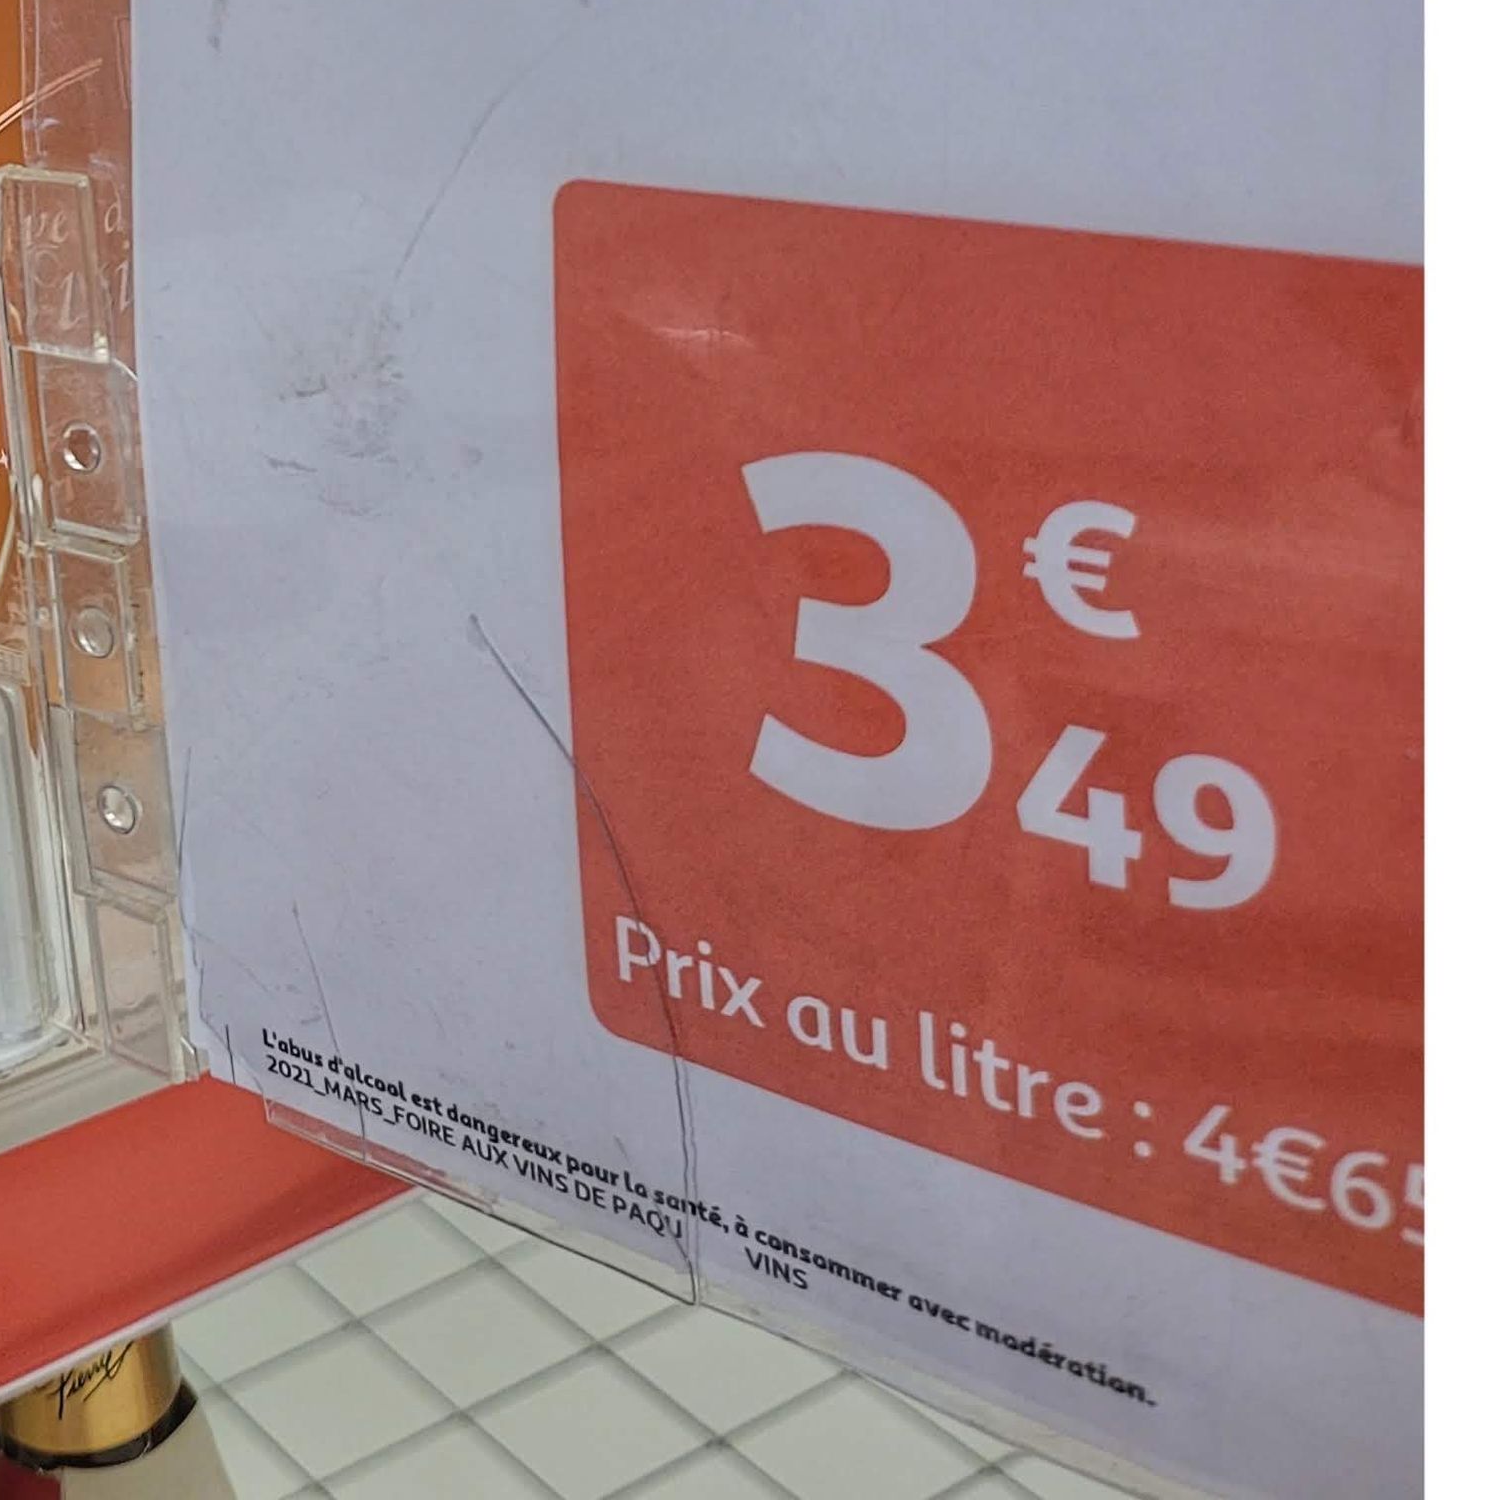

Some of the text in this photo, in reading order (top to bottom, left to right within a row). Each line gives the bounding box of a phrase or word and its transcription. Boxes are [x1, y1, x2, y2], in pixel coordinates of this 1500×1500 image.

[740, 450, 993, 832] 3
[1023, 500, 1141, 640] €
[1016, 724, 1278, 911] 49
[615, 915, 765, 1028] Prix
[787, 994, 888, 1070] au
[918, 1011, 1105, 1139] litre
[262, 1028, 1158, 1407] L'abus d'alcool est dangereux pour la santé, à consommer avec modération.
[461, 1132, 511, 1169] AUX
[513, 1155, 568, 1195] VINS
[575, 1179, 607, 1209] DE
[612, 1194, 683, 1240] PAQU
[744, 1246, 810, 1291] VINS
